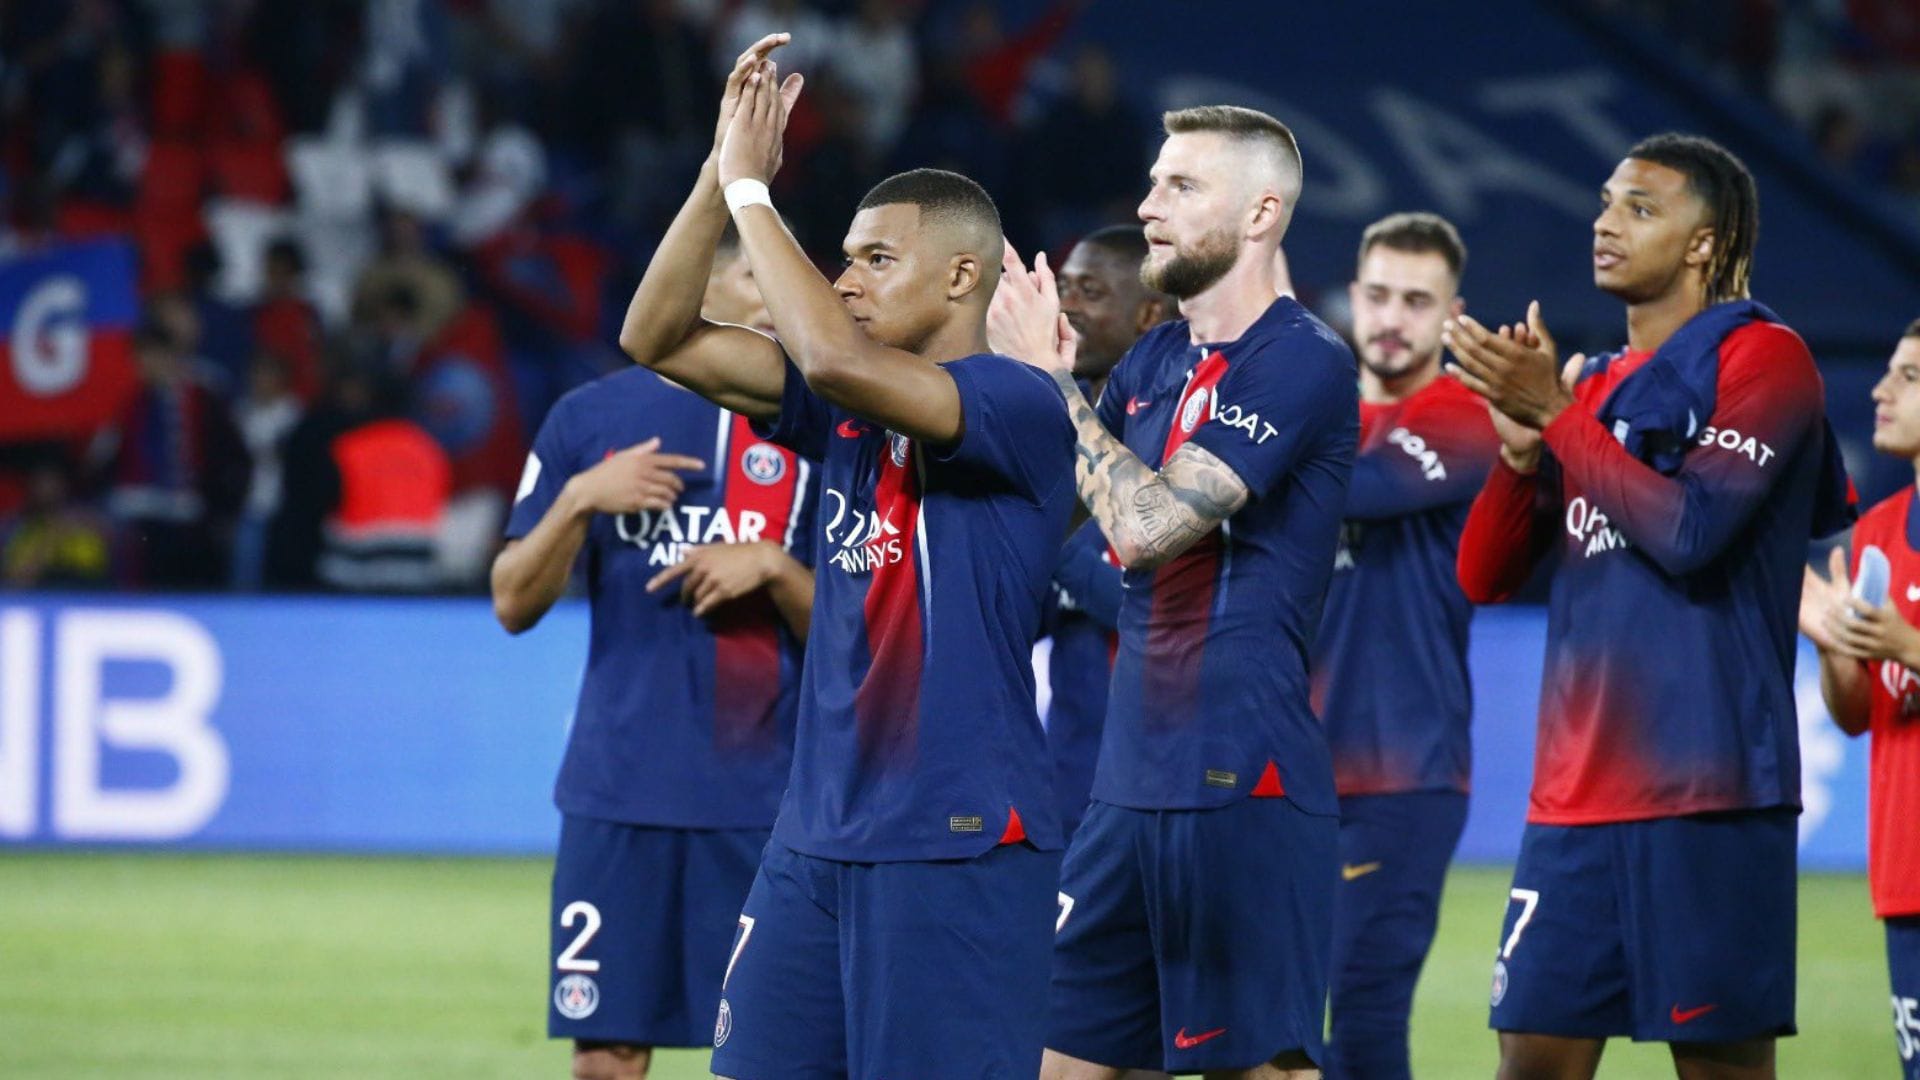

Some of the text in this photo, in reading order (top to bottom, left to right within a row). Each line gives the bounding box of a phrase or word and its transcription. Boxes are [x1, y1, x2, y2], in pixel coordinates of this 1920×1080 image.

[13, 276, 90, 396] G
[1216, 404, 1279, 444] OAT
[1698, 426, 1775, 467] GOAT
[1387, 426, 1447, 481] GOAT
[615, 505, 767, 549] QATAR
[557, 901, 602, 971] 2
[723, 914, 755, 990] 7
